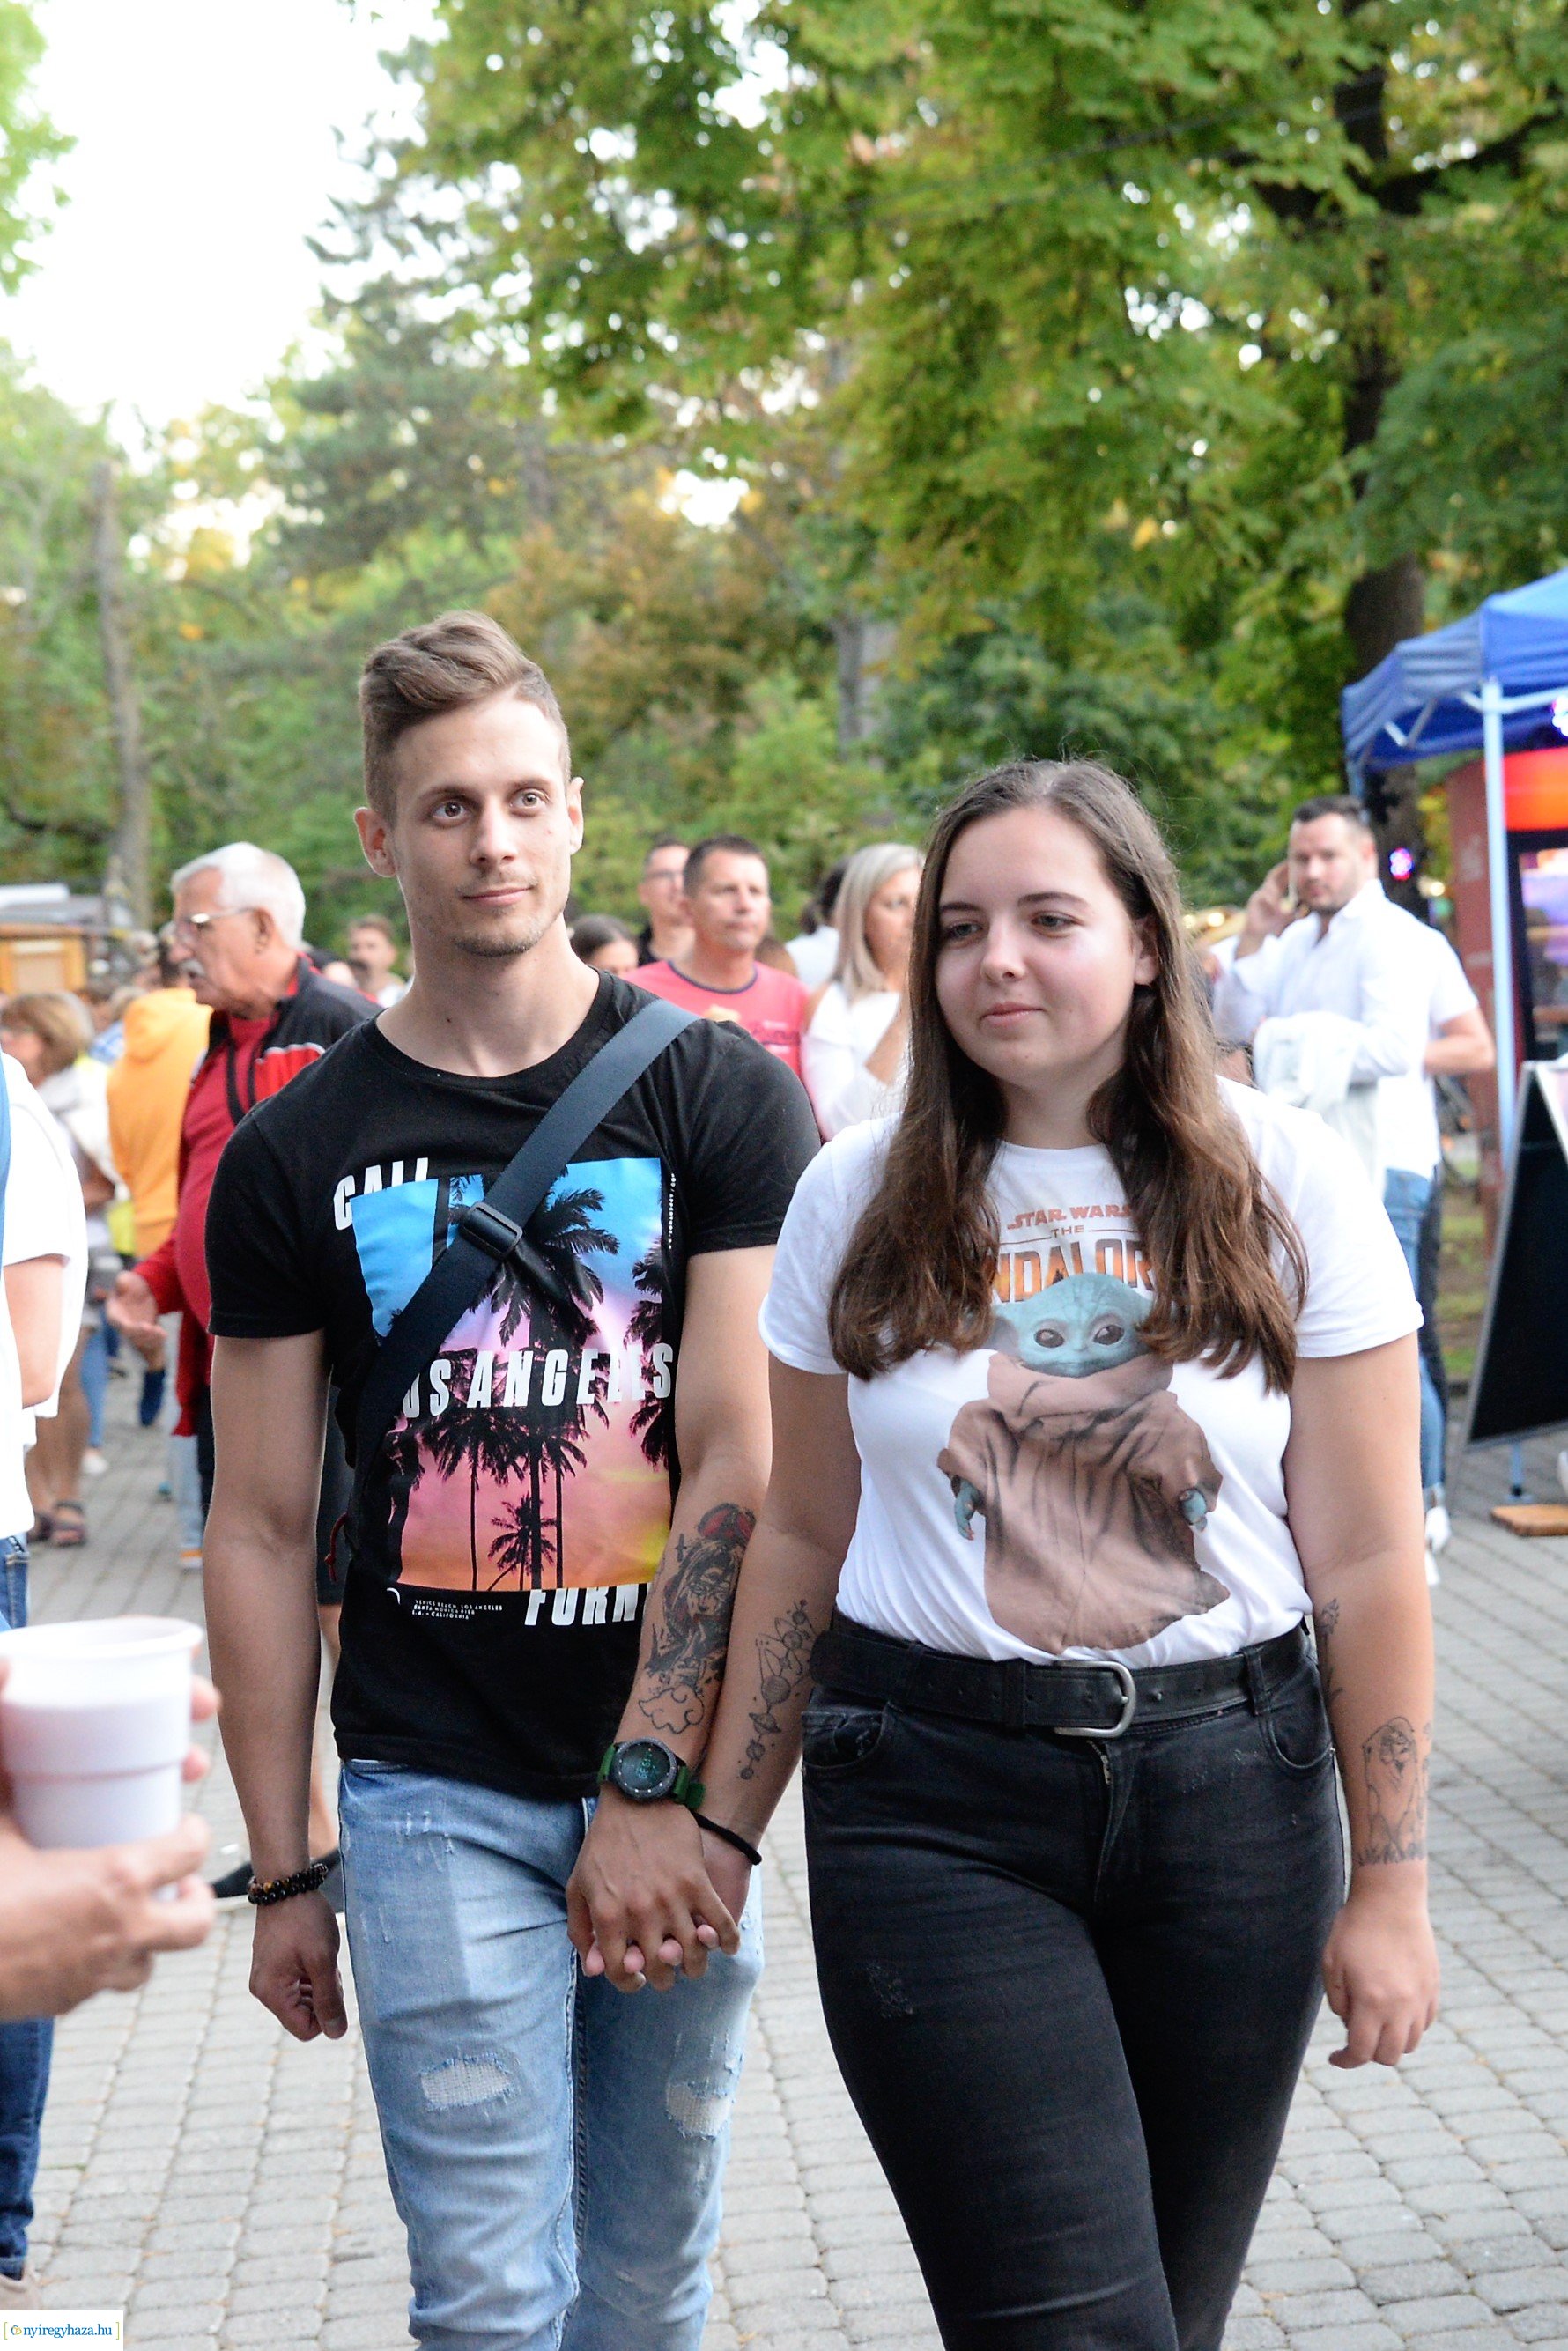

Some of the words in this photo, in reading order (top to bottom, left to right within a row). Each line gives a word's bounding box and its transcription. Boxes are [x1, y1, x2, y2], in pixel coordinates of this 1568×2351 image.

[1007, 1209, 1067, 1230] STAR
[1051, 1224, 1085, 1238] THE
[993, 1238, 1155, 1303] NDALOR
[403, 1358, 452, 1417] OS
[467, 1342, 674, 1408] ANGELES
[431, 1611, 470, 1620] CALIFORNIA
[524, 1583, 652, 1626] FORN
